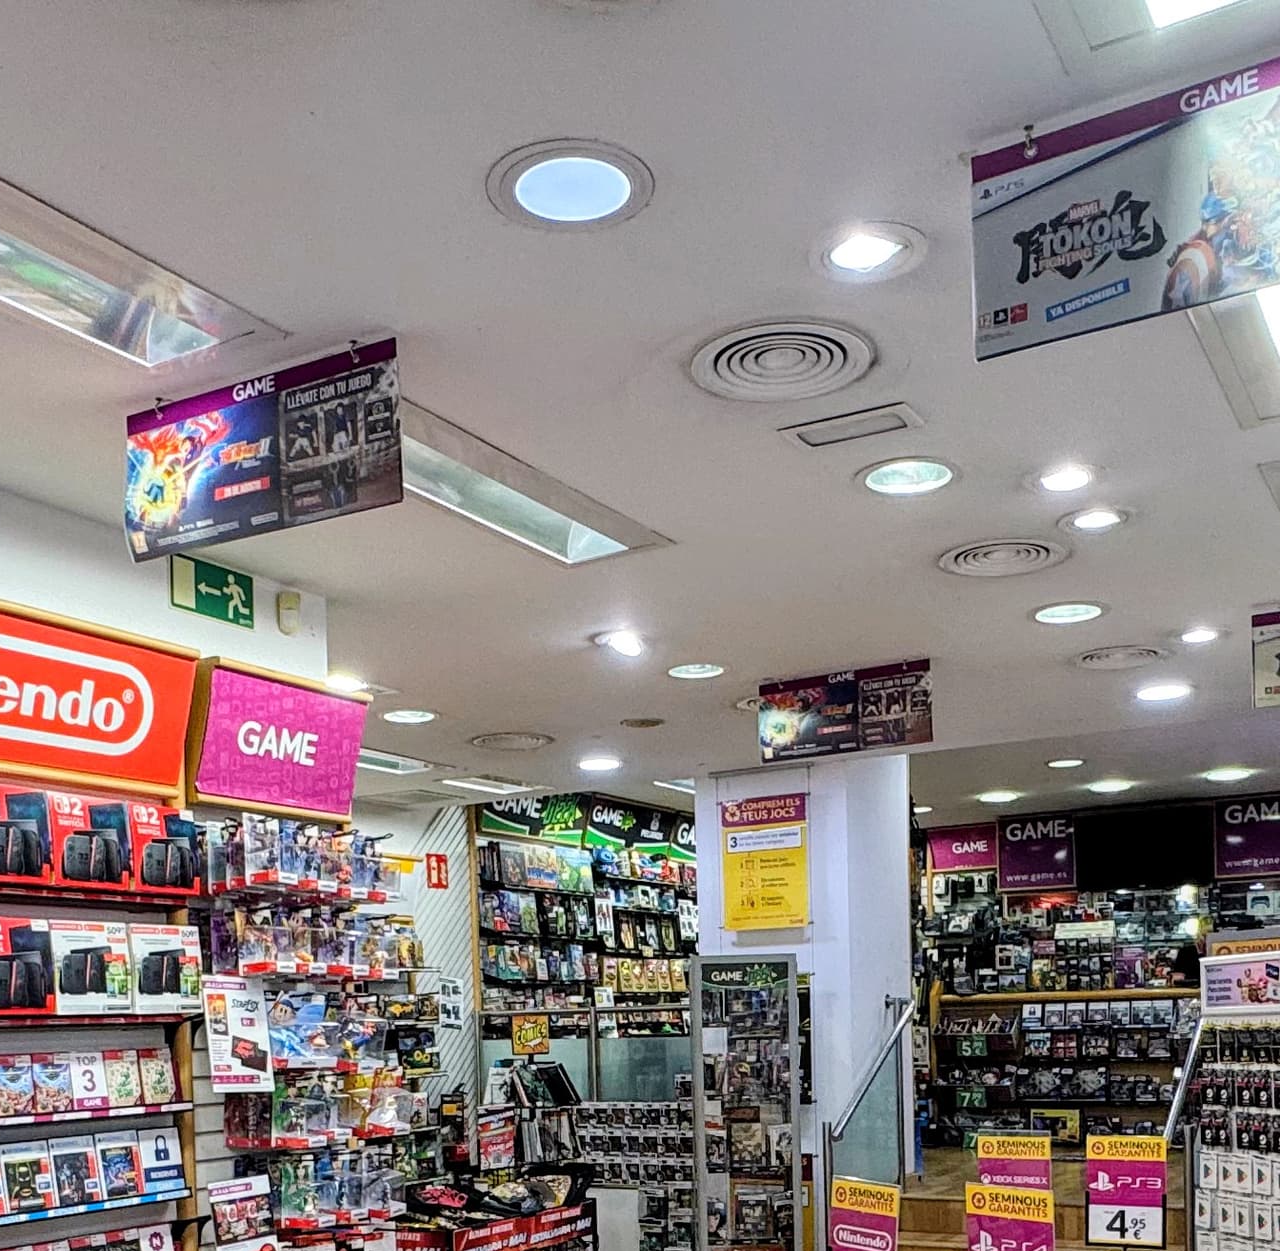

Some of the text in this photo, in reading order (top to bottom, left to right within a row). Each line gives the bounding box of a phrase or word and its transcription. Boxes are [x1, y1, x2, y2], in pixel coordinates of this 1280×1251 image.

[1180, 69, 1259, 113] GAME
[1050, 283, 1124, 316] YA DISPONIBLE
[233, 375, 275, 402] GAME
[348, 374, 371, 393] JUEGO
[237, 720, 319, 768] GAME
[741, 799, 785, 811] COMPREM
[593, 805, 623, 827] GAME
[742, 808, 796, 822] TEUS JOCS
[1006, 820, 1067, 841] GAME
[952, 840, 988, 855] GAME
[1007, 871, 1067, 883] www.game.es
[711, 970, 743, 981] GAME
[76, 1056, 97, 1067] TOP
[81, 1067, 97, 1092] 3
[996, 1140, 1045, 1152] SEMINOUS
[1107, 1139, 1162, 1151] SEMINOUS
[1117, 1175, 1162, 1189] PS3
[848, 1187, 895, 1203] SEMINOUS
[988, 1192, 1048, 1208] SEMINOUS
[847, 1198, 895, 1213] GARANTITS
[989, 1202, 1048, 1218] GARANTITS
[837, 1230, 888, 1249] Nintendo
